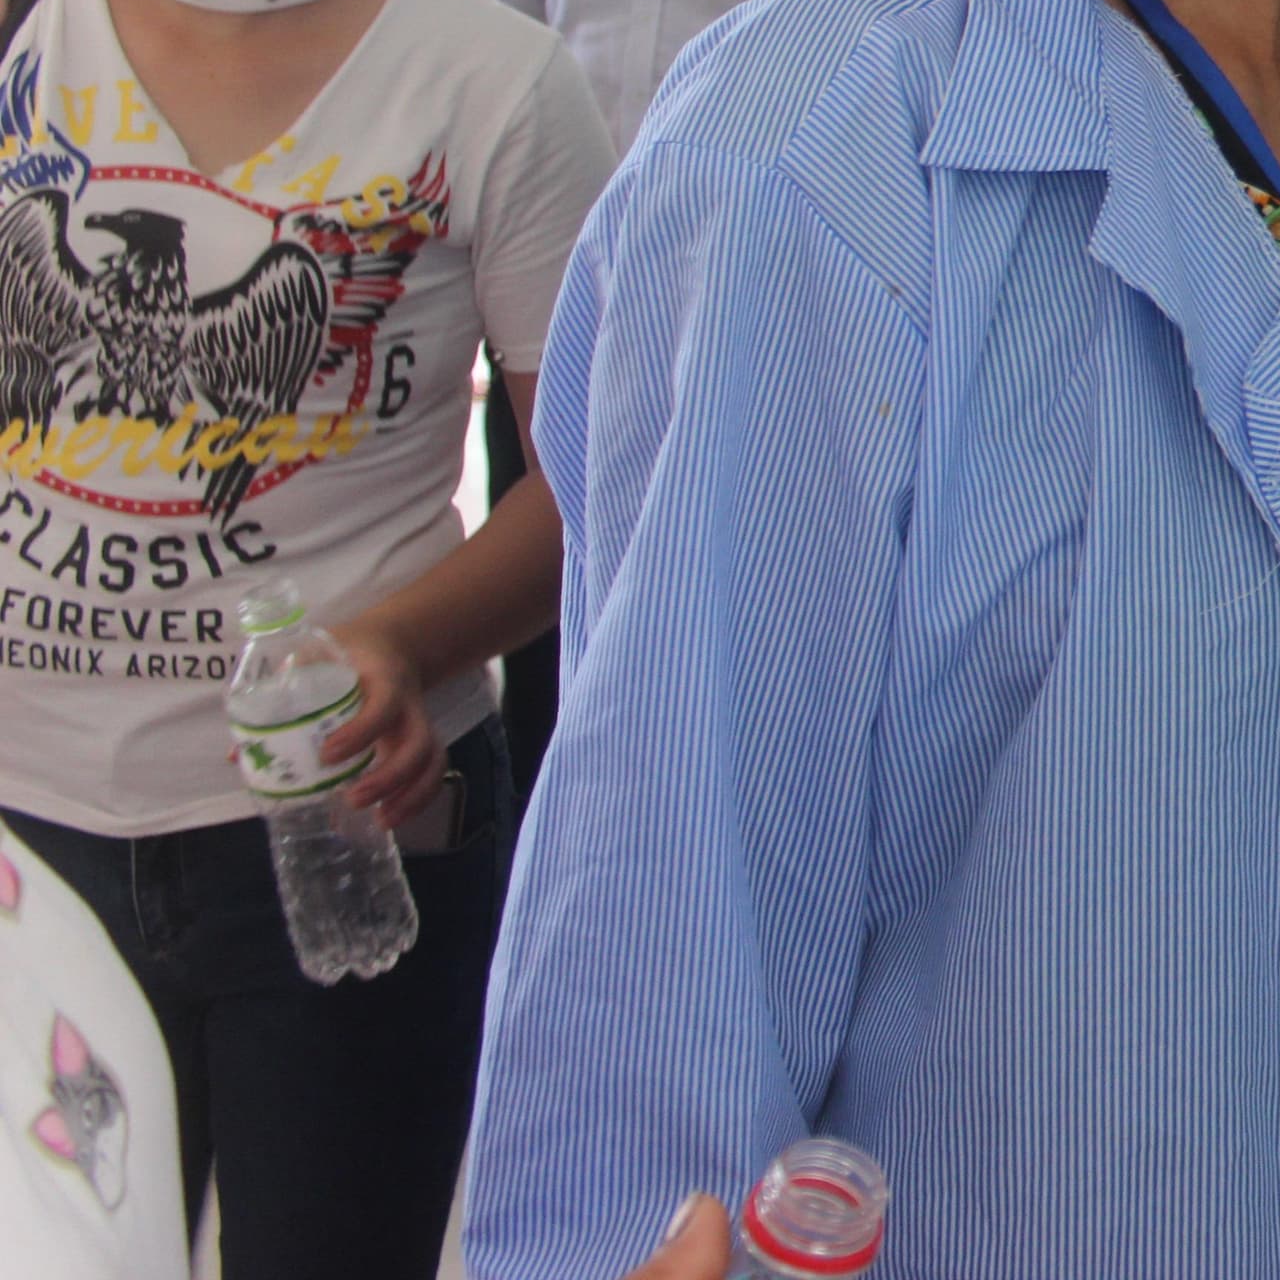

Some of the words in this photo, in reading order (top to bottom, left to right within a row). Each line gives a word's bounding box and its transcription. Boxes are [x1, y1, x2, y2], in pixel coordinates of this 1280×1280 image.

[0, 490, 277, 594] CLASSIC
[0, 588, 223, 643] FOREVER
[0, 635, 104, 677] EONIX
